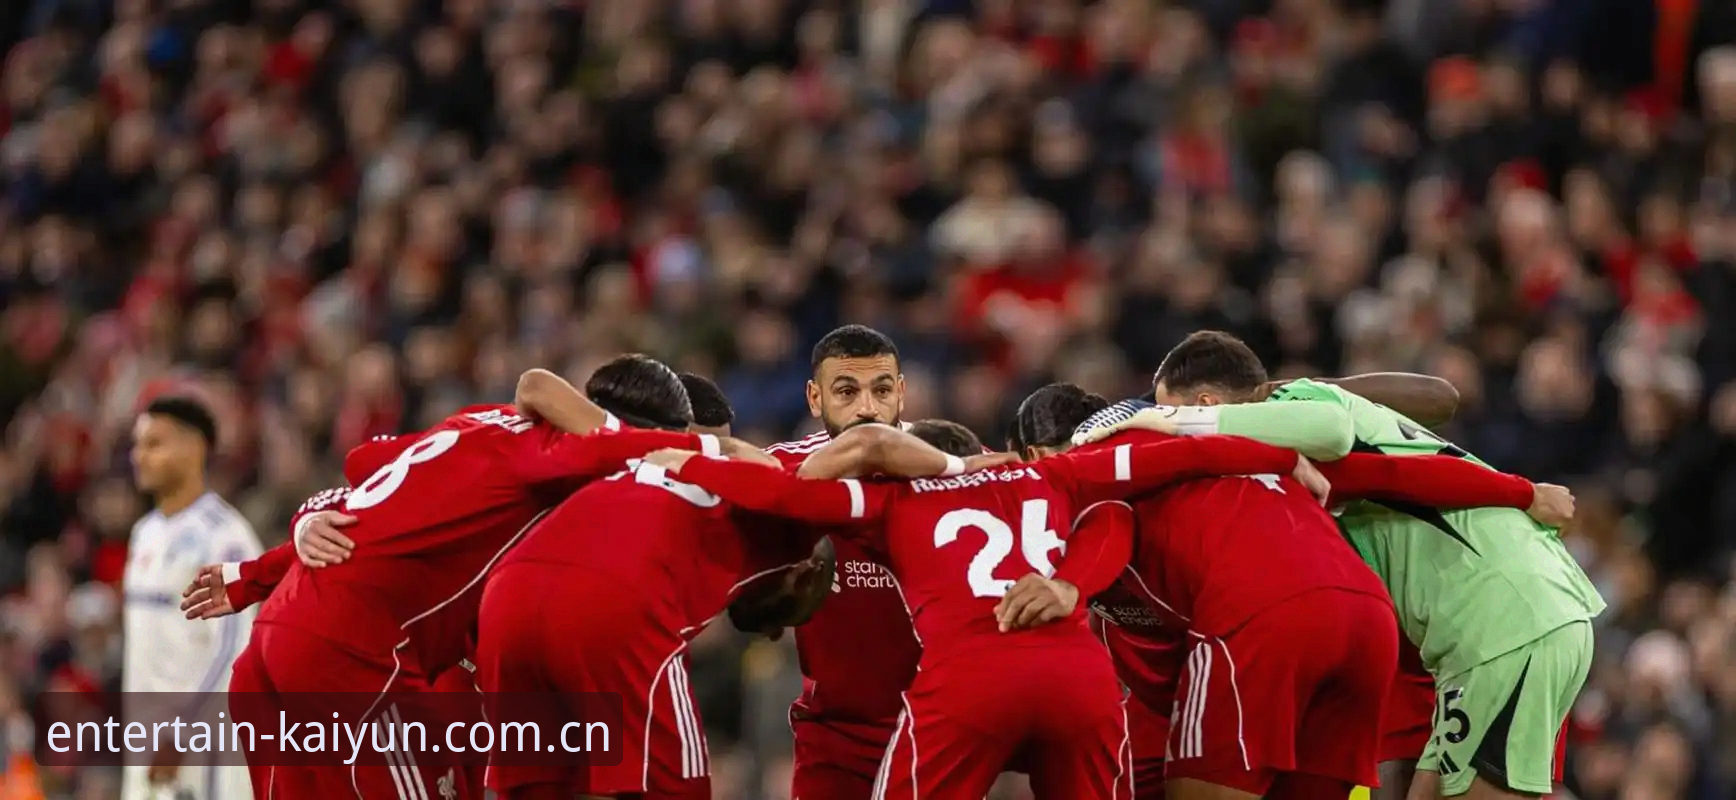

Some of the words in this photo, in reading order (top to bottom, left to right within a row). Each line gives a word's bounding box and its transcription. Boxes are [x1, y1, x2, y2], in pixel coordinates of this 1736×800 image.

[345, 430, 460, 511] 8
[934, 499, 1067, 598] 26
[1435, 689, 1470, 744] 5
